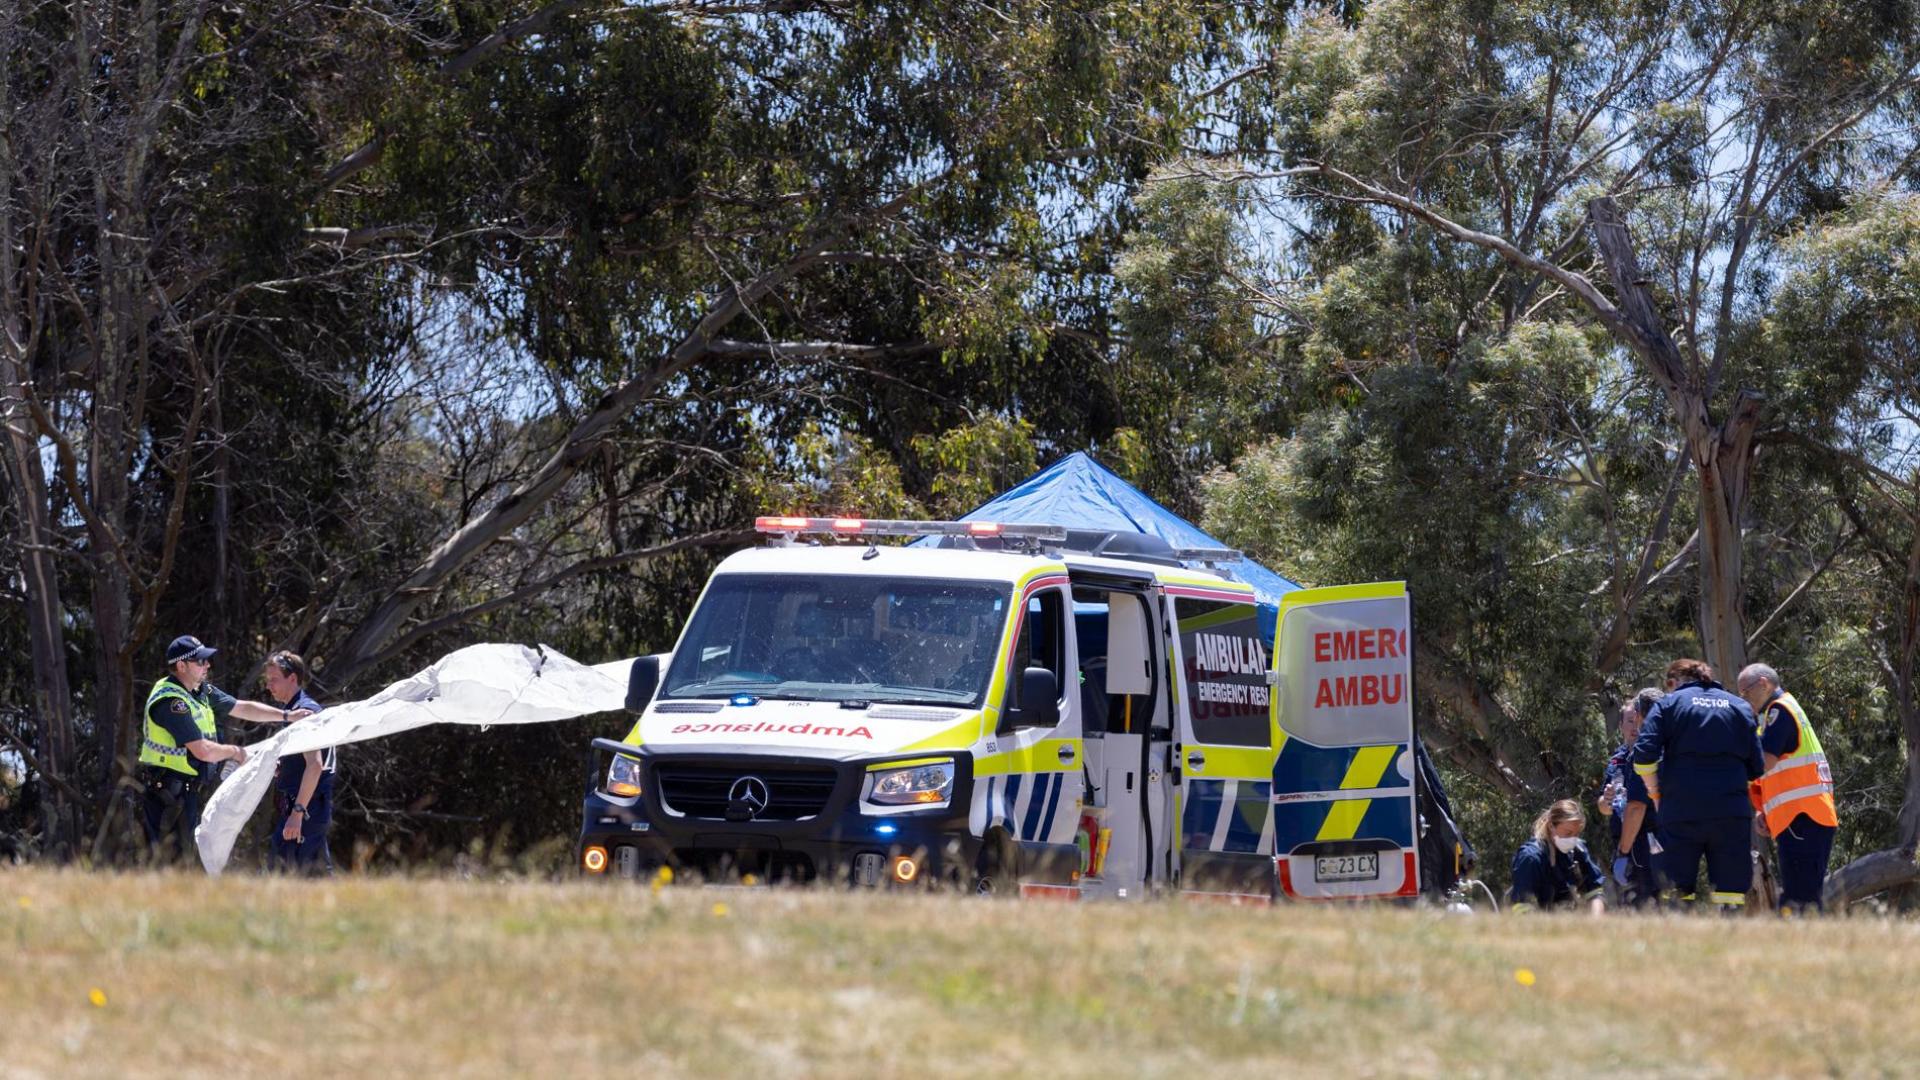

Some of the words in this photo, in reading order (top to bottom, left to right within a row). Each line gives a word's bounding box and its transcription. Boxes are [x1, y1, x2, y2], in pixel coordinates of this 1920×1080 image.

[1198, 681, 1248, 705] EMERGENCY
[1314, 673, 1407, 708] AMBU
[1692, 696, 1729, 708] DOCTOR
